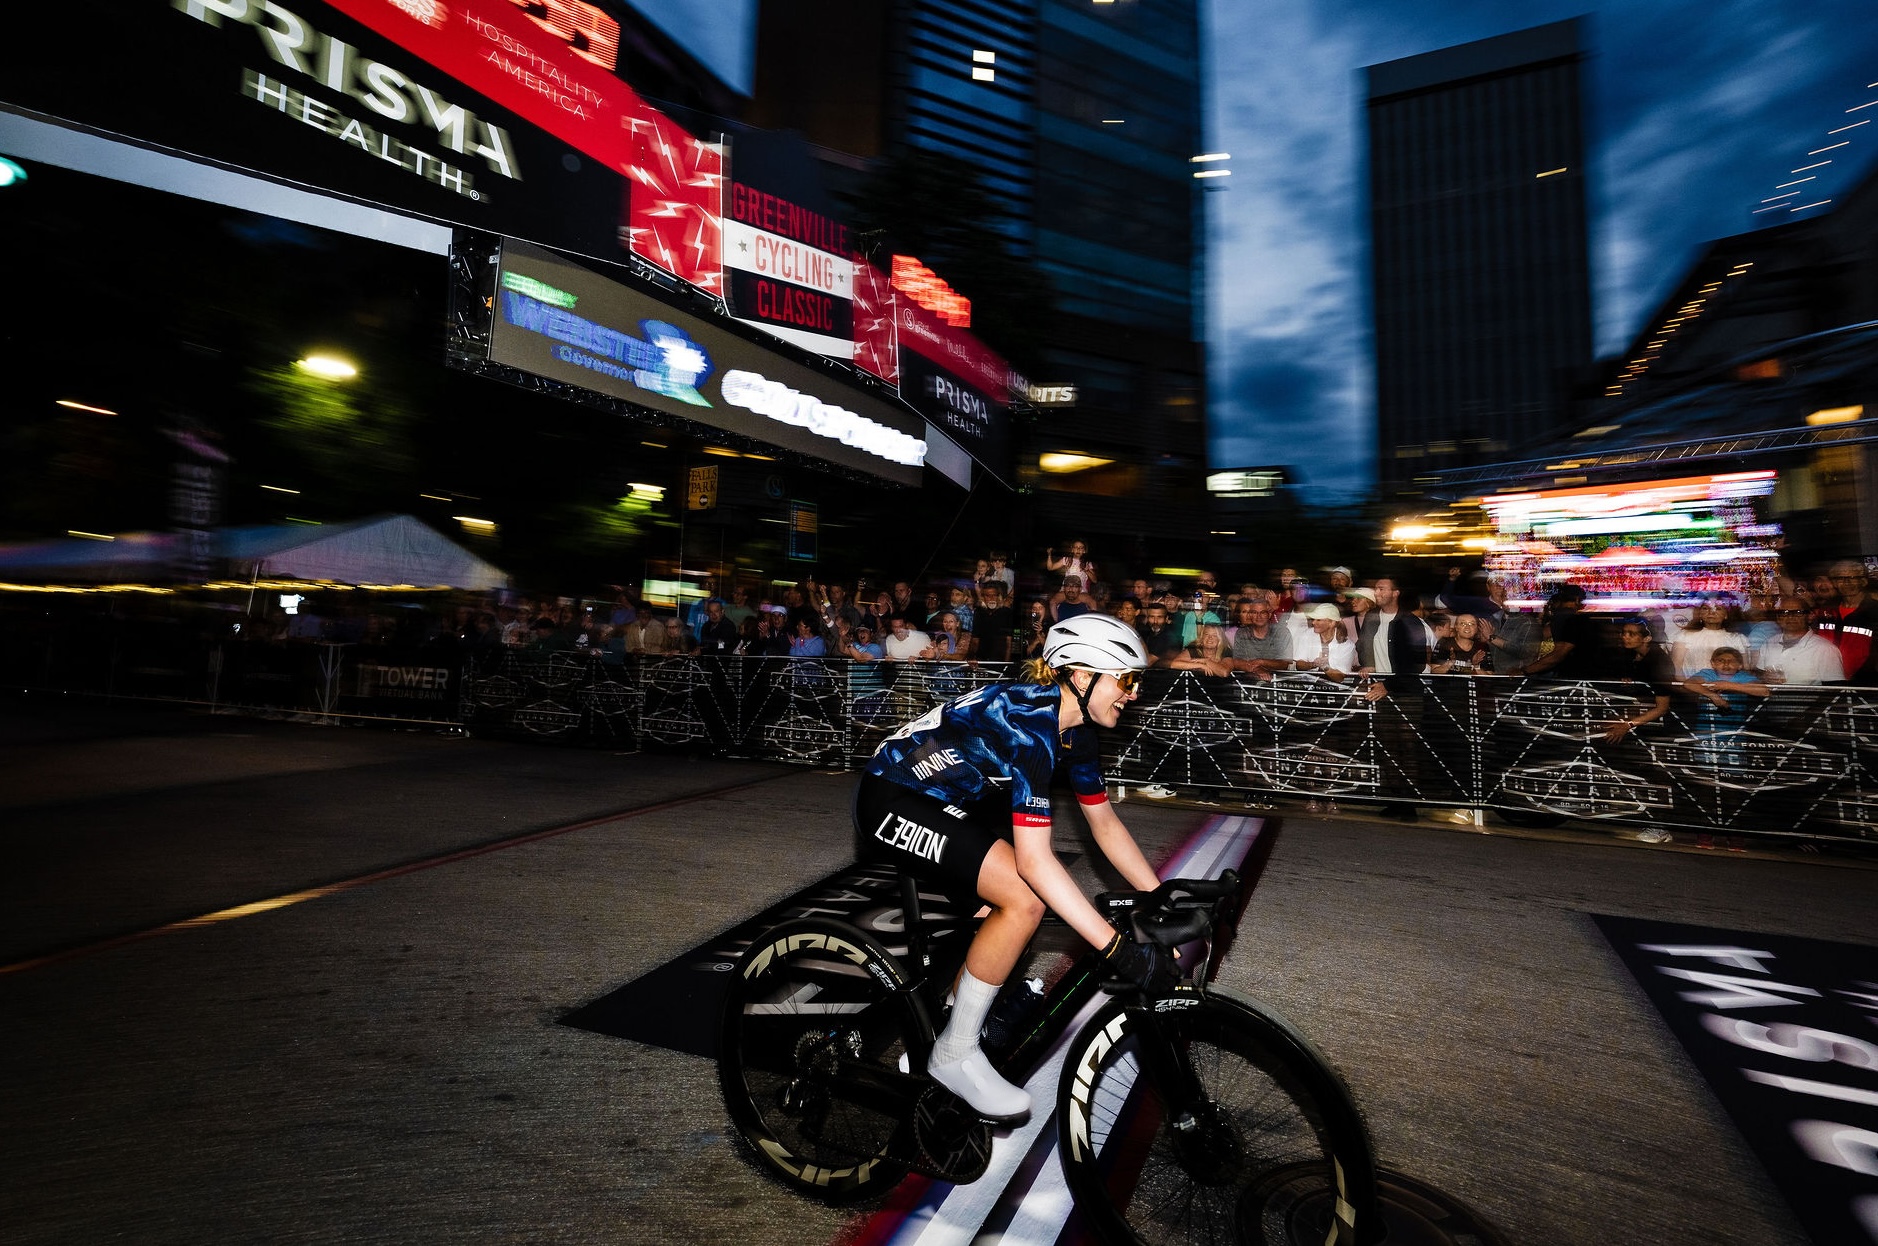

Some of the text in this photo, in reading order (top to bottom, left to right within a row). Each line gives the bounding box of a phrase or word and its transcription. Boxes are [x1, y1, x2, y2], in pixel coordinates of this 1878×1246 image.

[466, 9, 603, 110] HOSPITALITY
[487, 50, 587, 121] AMERICA
[732, 181, 849, 256] GREENVILLE
[755, 234, 833, 290] CYCLING
[757, 280, 833, 331] CLASSIC
[935, 375, 989, 425] PRISMA
[947, 410, 981, 438] HEALTH
[691, 481, 716, 493] PARK
[376, 665, 449, 689] TOWER
[1539, 695, 1568, 703] GRAN
[1700, 740, 1786, 750] GRAN FONDO
[1546, 771, 1575, 780] GRAN
[1155, 998, 1199, 1008] ZIPP
